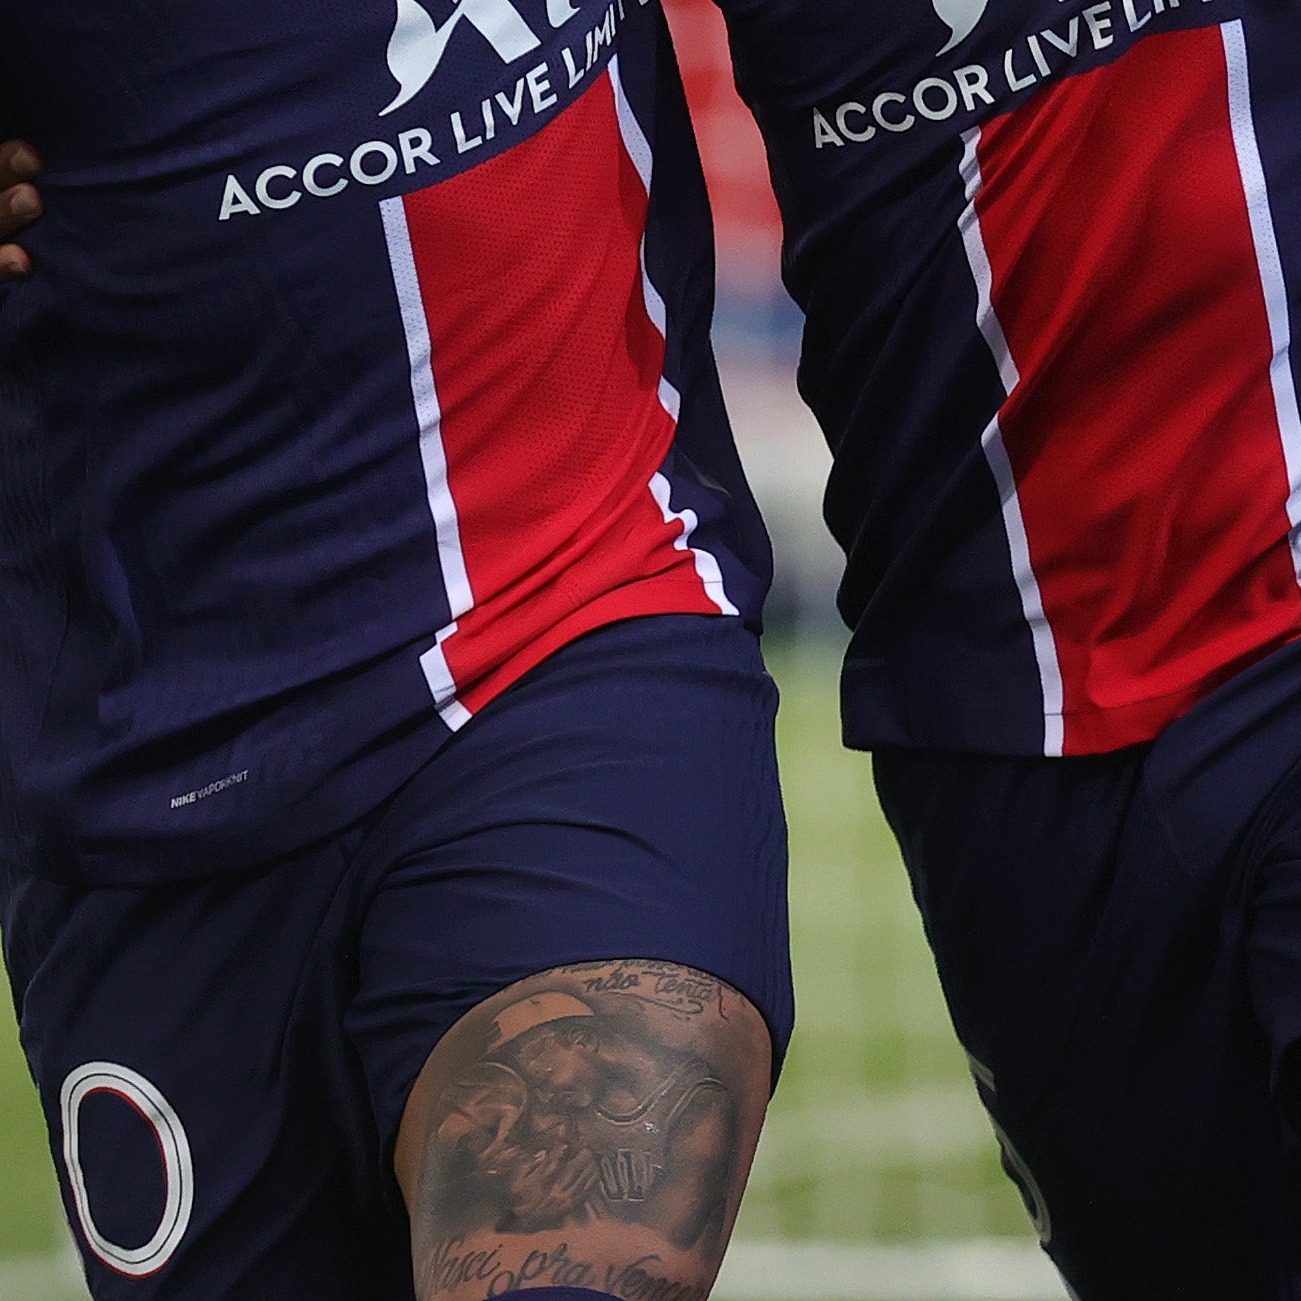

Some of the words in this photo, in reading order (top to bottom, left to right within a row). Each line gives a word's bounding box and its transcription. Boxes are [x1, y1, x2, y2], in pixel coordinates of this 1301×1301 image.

[218, 127, 441, 221] ACCOR
[450, 62, 559, 154] LIVE
[813, 64, 996, 149] ACCOR
[1003, 1, 1114, 92] LIVE
